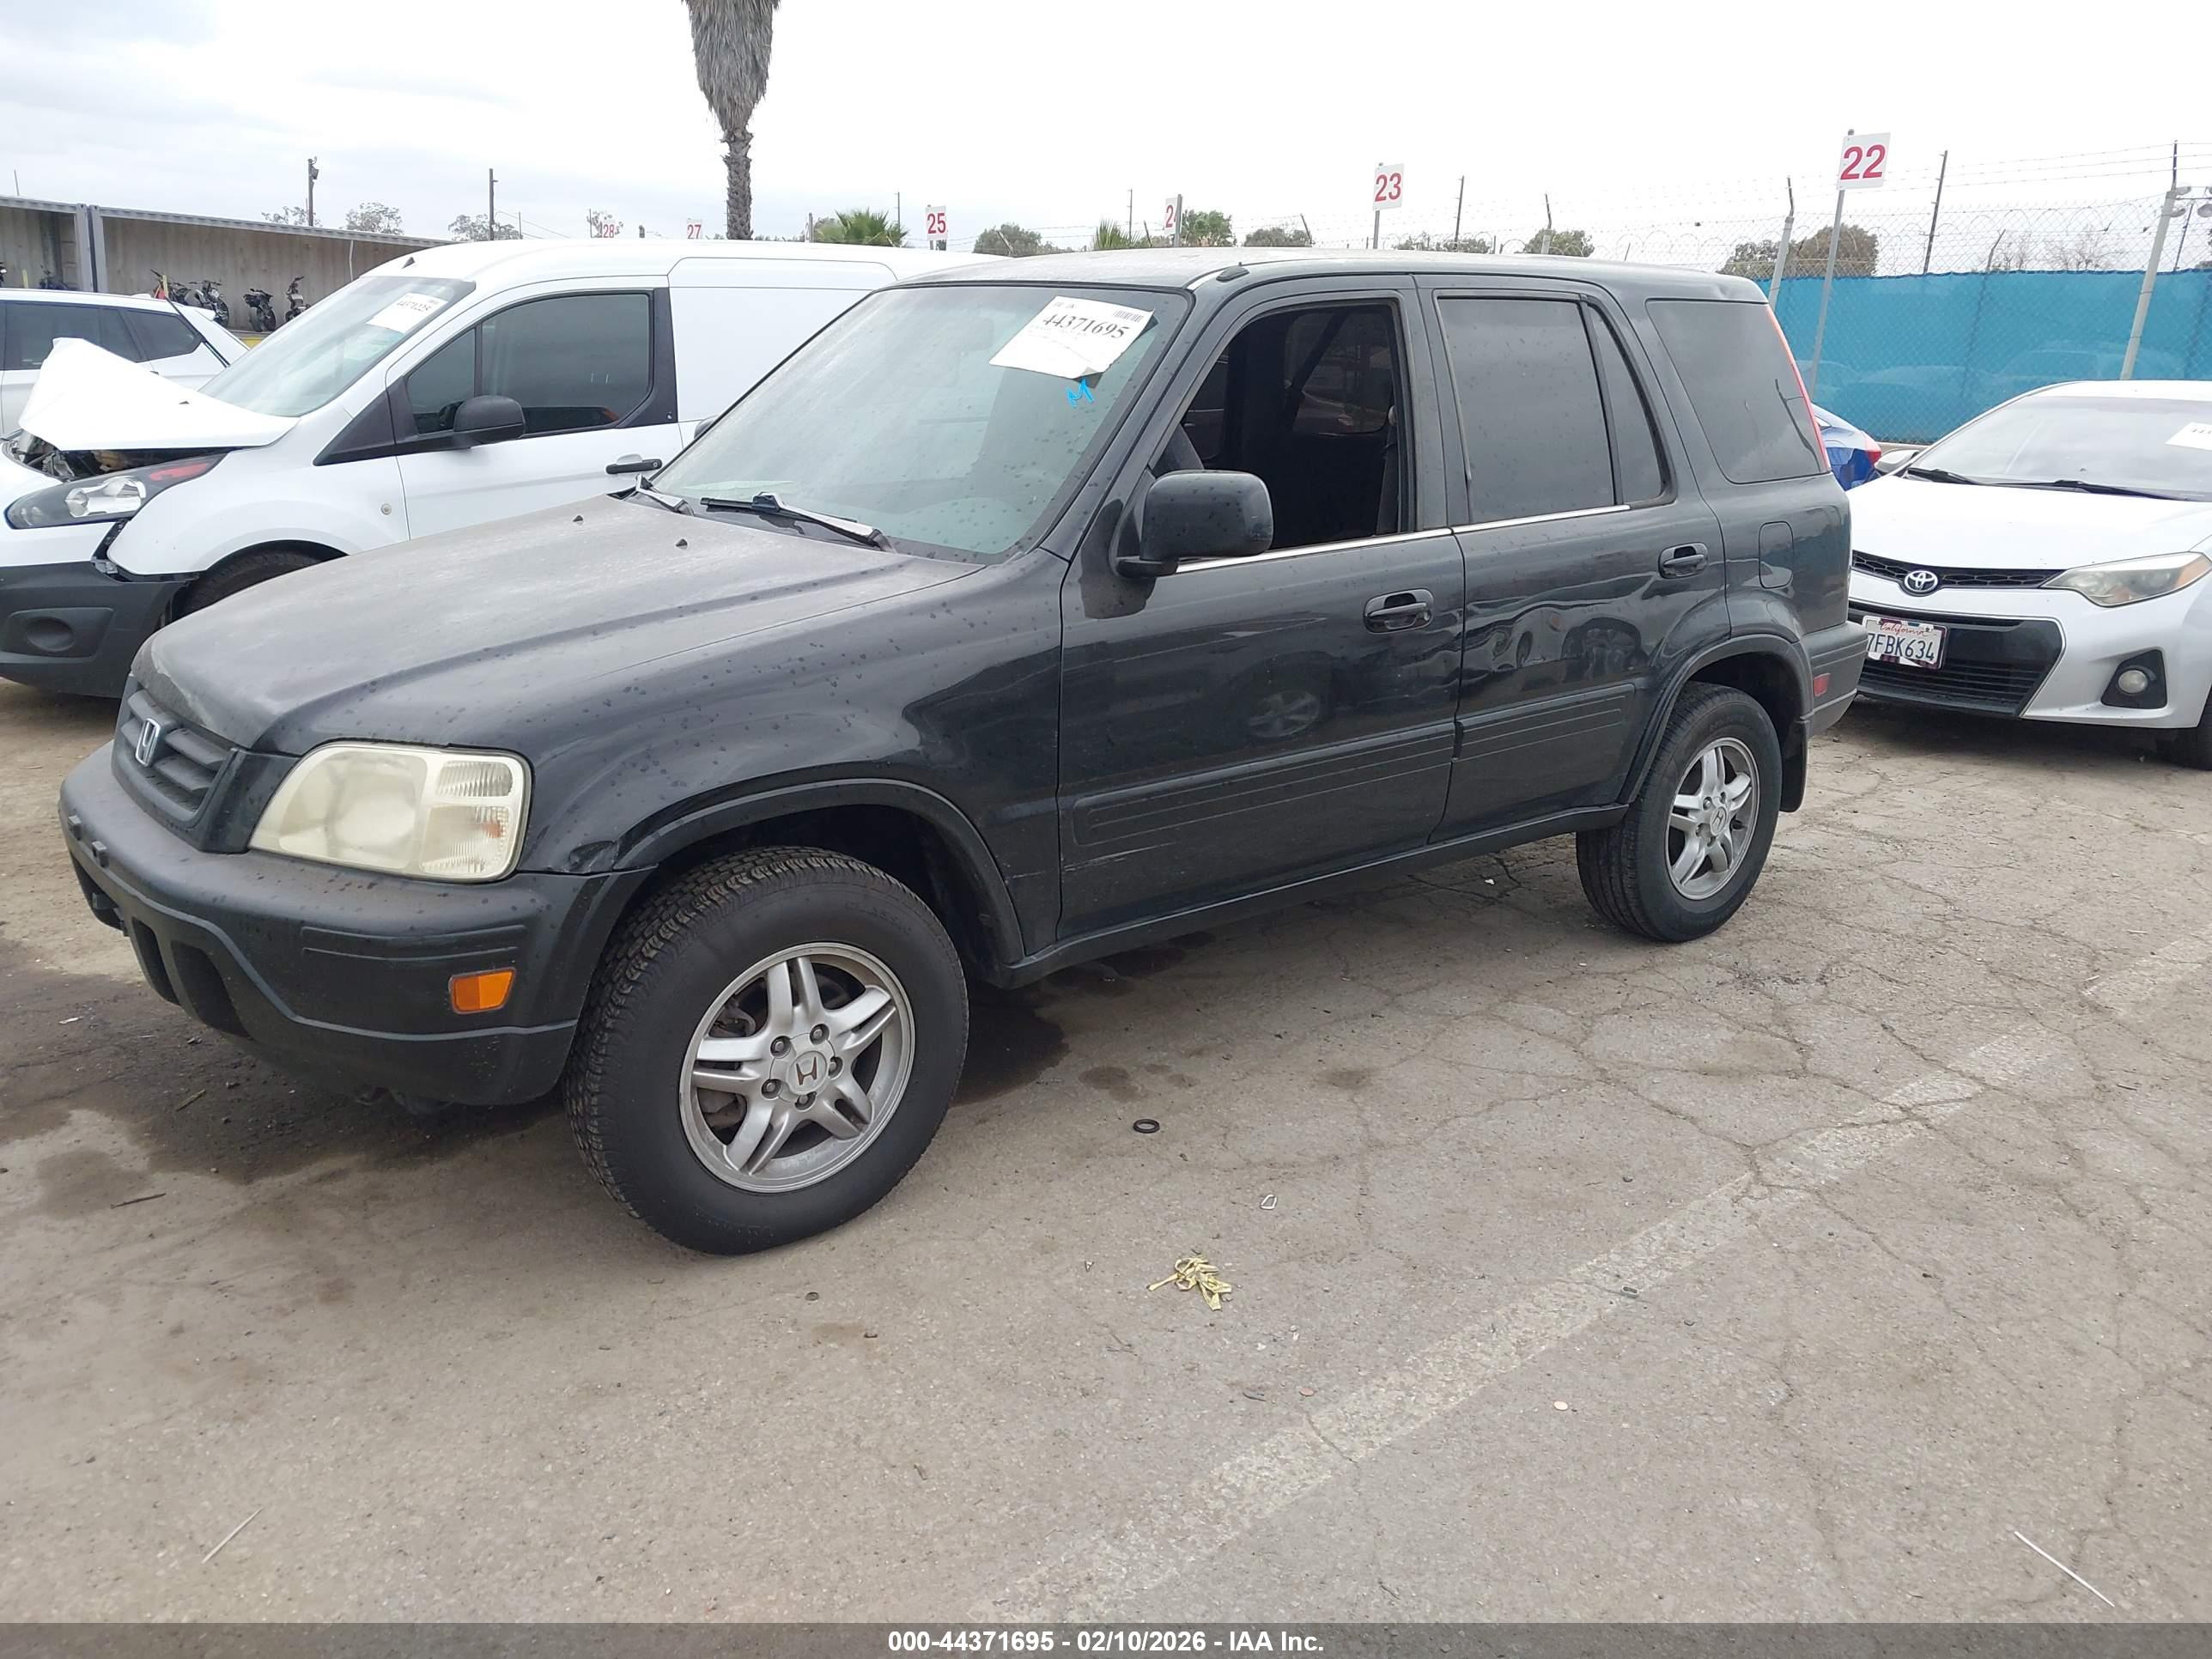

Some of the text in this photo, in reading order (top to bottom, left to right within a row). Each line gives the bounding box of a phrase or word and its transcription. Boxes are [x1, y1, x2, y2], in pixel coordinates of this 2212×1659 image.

[1840, 144, 1886, 180] 22
[1373, 171, 1402, 203] 23
[602, 223, 615, 239] 28
[686, 223, 702, 240] 27
[926, 211, 947, 234] 25
[1043, 313, 1130, 338] 44371695
[1879, 621, 1925, 637] California
[1866, 632, 1935, 661] 7FBK634
